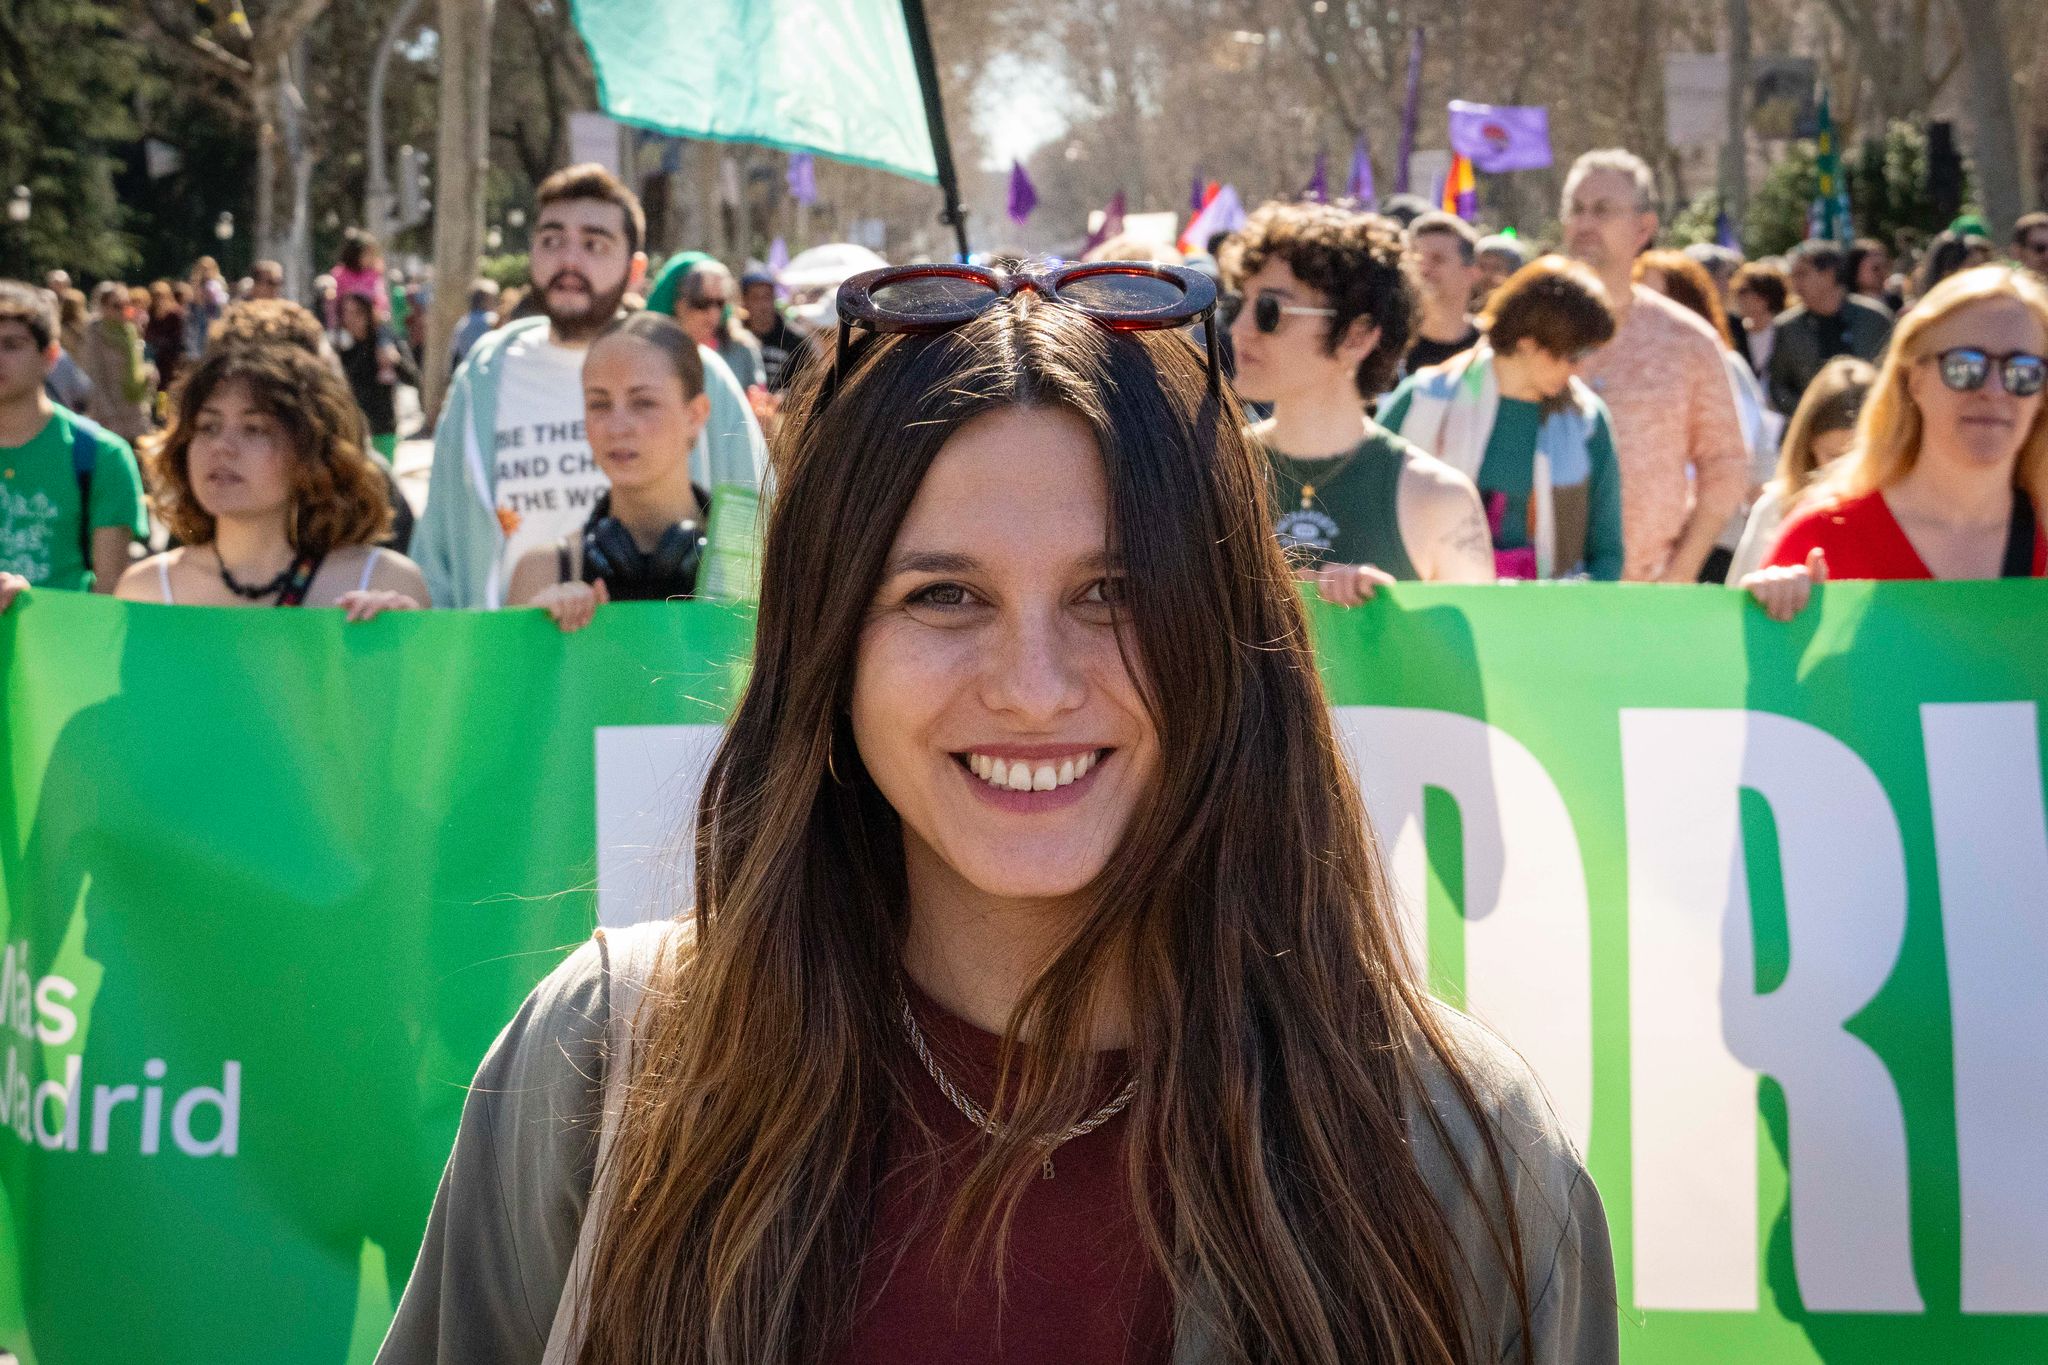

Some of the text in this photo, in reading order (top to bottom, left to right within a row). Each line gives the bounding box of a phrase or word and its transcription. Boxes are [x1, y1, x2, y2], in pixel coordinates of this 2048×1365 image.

[533, 420, 585, 443] THE
[496, 456, 550, 479] AND
[508, 488, 557, 511] THE
